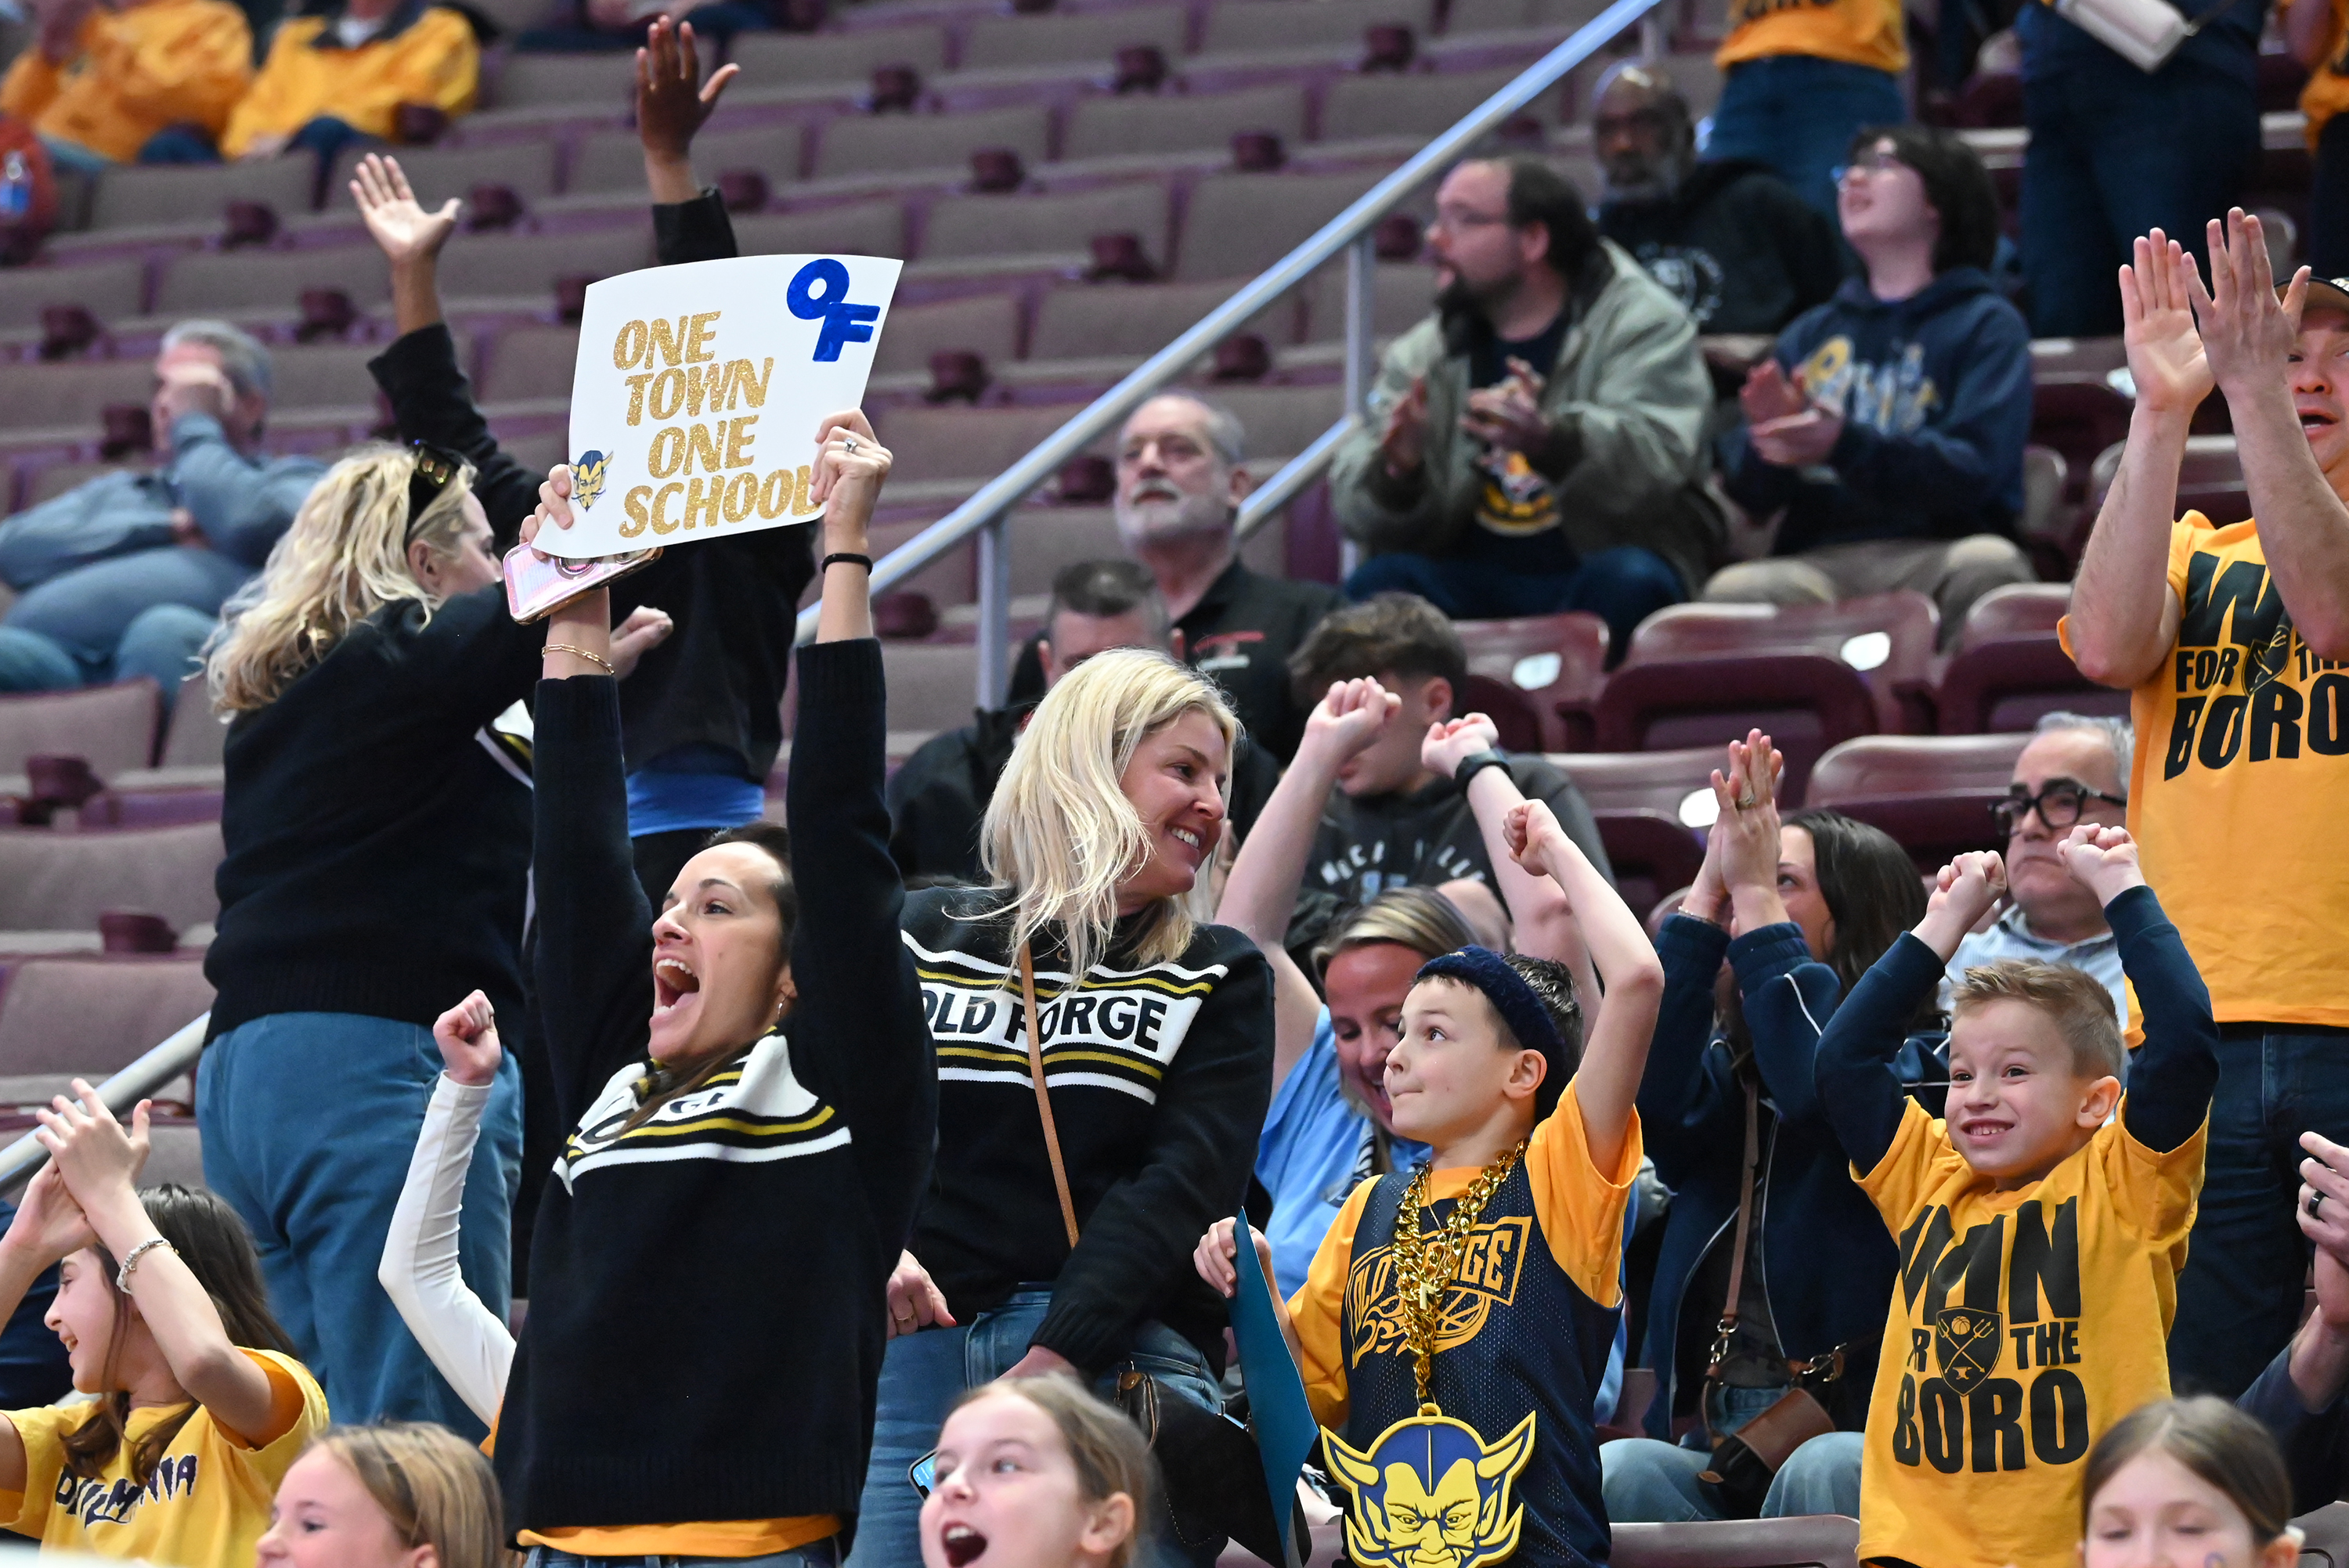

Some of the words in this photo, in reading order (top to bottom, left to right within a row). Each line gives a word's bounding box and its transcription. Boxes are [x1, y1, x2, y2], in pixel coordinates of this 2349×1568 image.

[613, 311, 721, 370] ONE
[625, 357, 774, 427] TOWN
[648, 414, 760, 479] ONE
[619, 464, 821, 538] SCHOOL
[2176, 648, 2239, 692] FOR
[2164, 673, 2349, 781] BORO
[1005, 997, 1167, 1052] FORGE
[1900, 1195, 2081, 1325] WIN
[2010, 1321, 2081, 1369] THE
[1893, 1368, 2089, 1473] BORO
